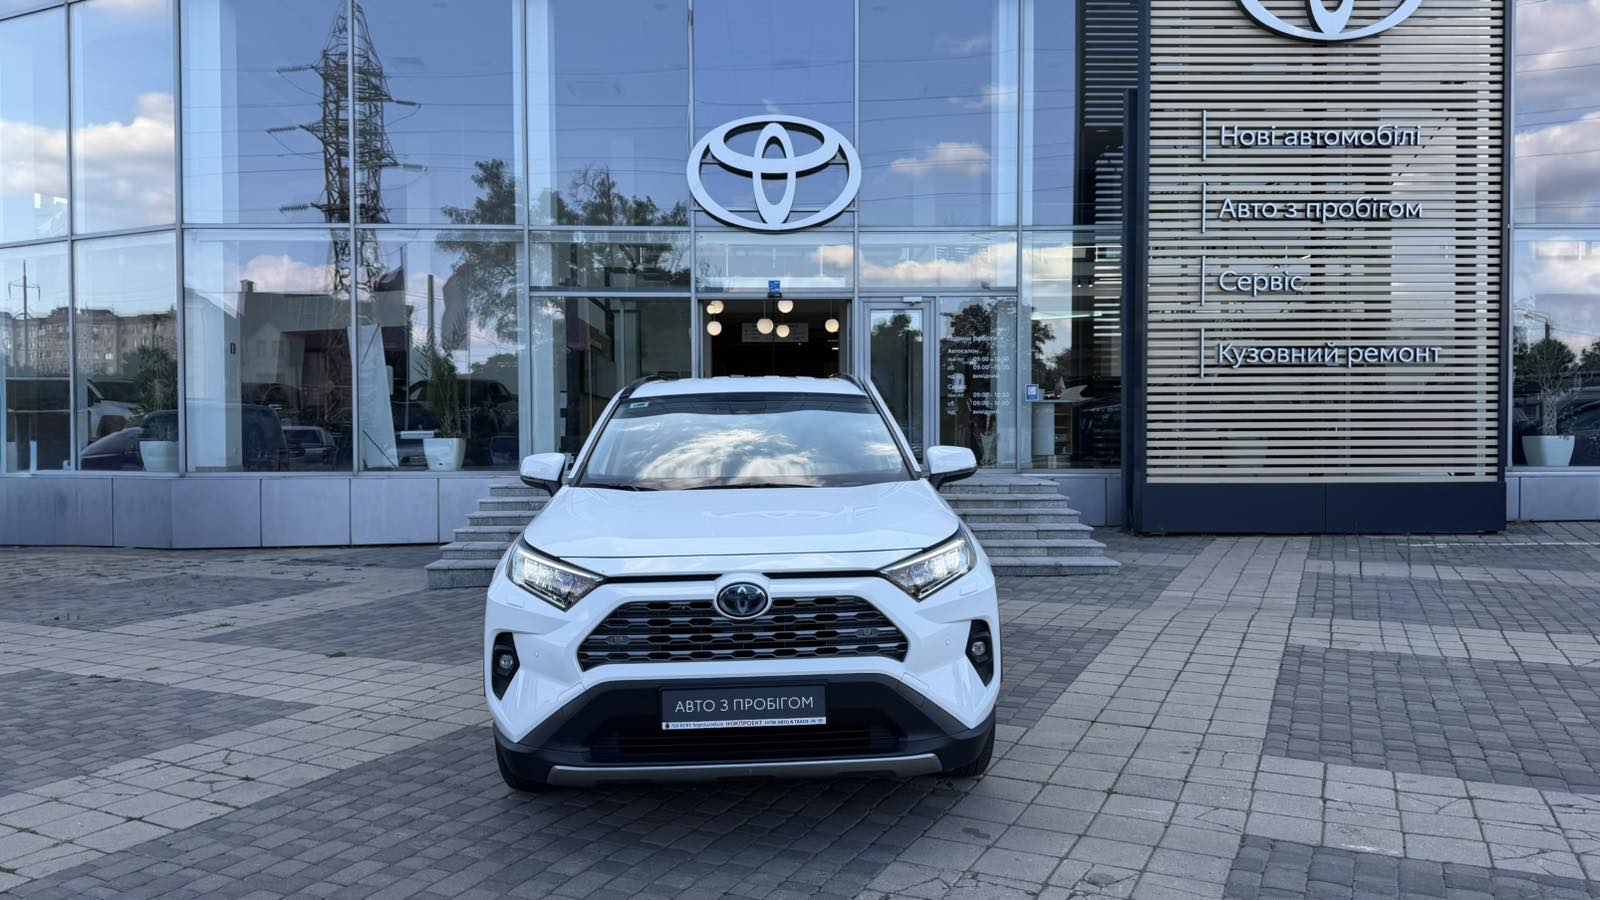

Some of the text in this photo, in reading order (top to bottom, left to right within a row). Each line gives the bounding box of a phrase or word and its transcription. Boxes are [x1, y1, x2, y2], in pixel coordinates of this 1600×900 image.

[1220, 124, 1422, 147] Нові автомобілі
[1219, 196, 1424, 223] Авто з пробігом
[1219, 271, 1304, 296] Сервіс
[1218, 341, 1442, 368] Кузовний ремонт
[674, 696, 814, 713] АВТО З ПРОБІГОМ
